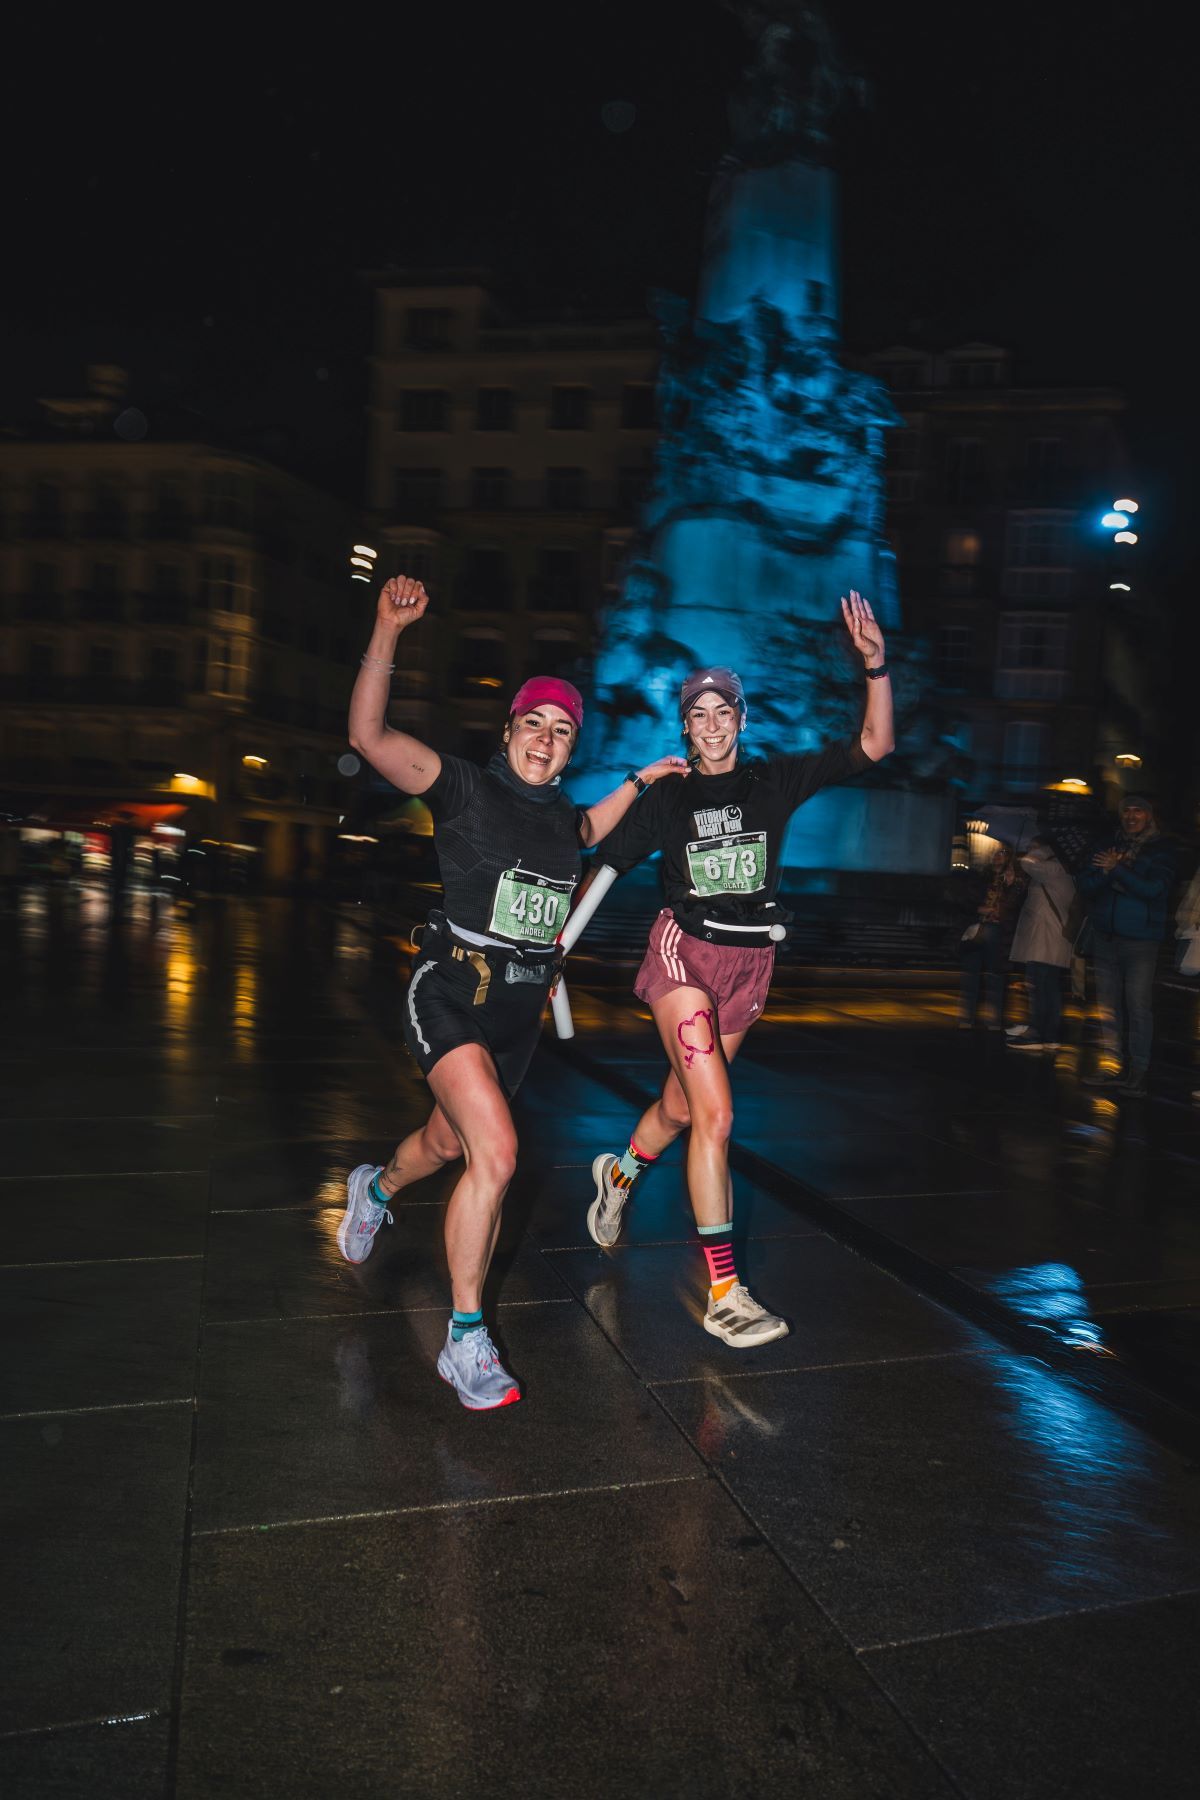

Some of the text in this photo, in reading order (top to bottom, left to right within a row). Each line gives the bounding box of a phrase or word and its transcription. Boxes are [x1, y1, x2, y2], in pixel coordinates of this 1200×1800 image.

[694, 809, 728, 826] VITORIA
[703, 849, 757, 880] 673
[723, 881, 746, 889] OLATZ
[510, 890, 559, 927] 430
[520, 926, 545, 938] ANDREA
